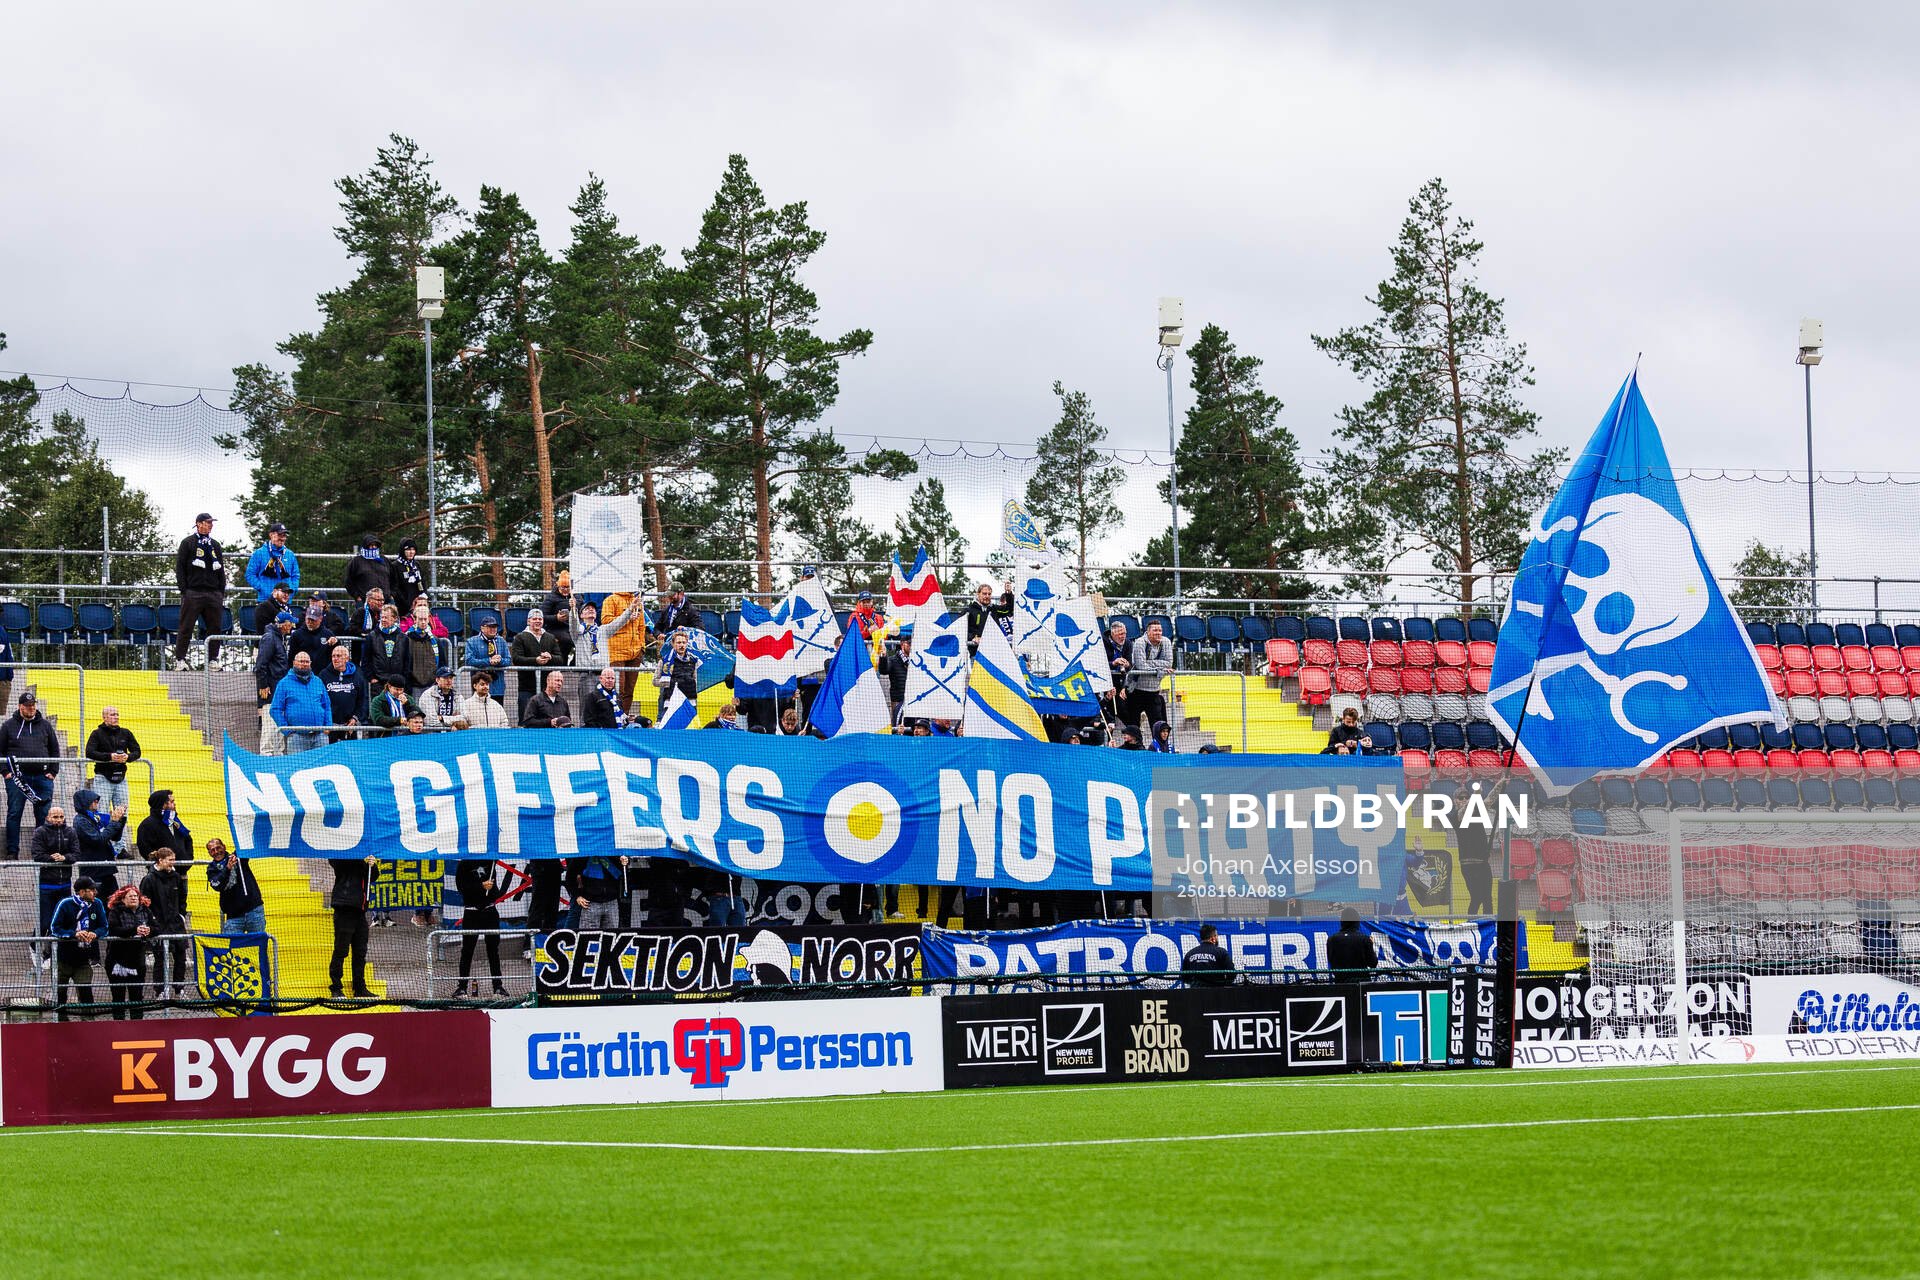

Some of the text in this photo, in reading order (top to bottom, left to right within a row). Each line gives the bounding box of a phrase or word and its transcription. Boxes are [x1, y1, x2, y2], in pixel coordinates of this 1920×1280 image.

[228, 752, 1397, 894] NO GIFFERS NO PARTY
[538, 929, 921, 991] SEKTION NORR
[1142, 999, 1168, 1024] BE
[1450, 977, 1465, 1055] SELECT
[1475, 978, 1495, 1057] SELECT
[1131, 1024, 1182, 1049] YOUR
[1316, 1040, 1334, 1049] WAVE
[528, 1031, 670, 1080] Gärdin
[748, 1025, 913, 1071] Persson
[1056, 1048, 1093, 1057] NEW WAVE
[1056, 1055, 1094, 1066] PROFILE
[1124, 1048, 1190, 1074] BRAND
[1299, 1048, 1335, 1058] PROFILE
[173, 1032, 387, 1101] BYGG
